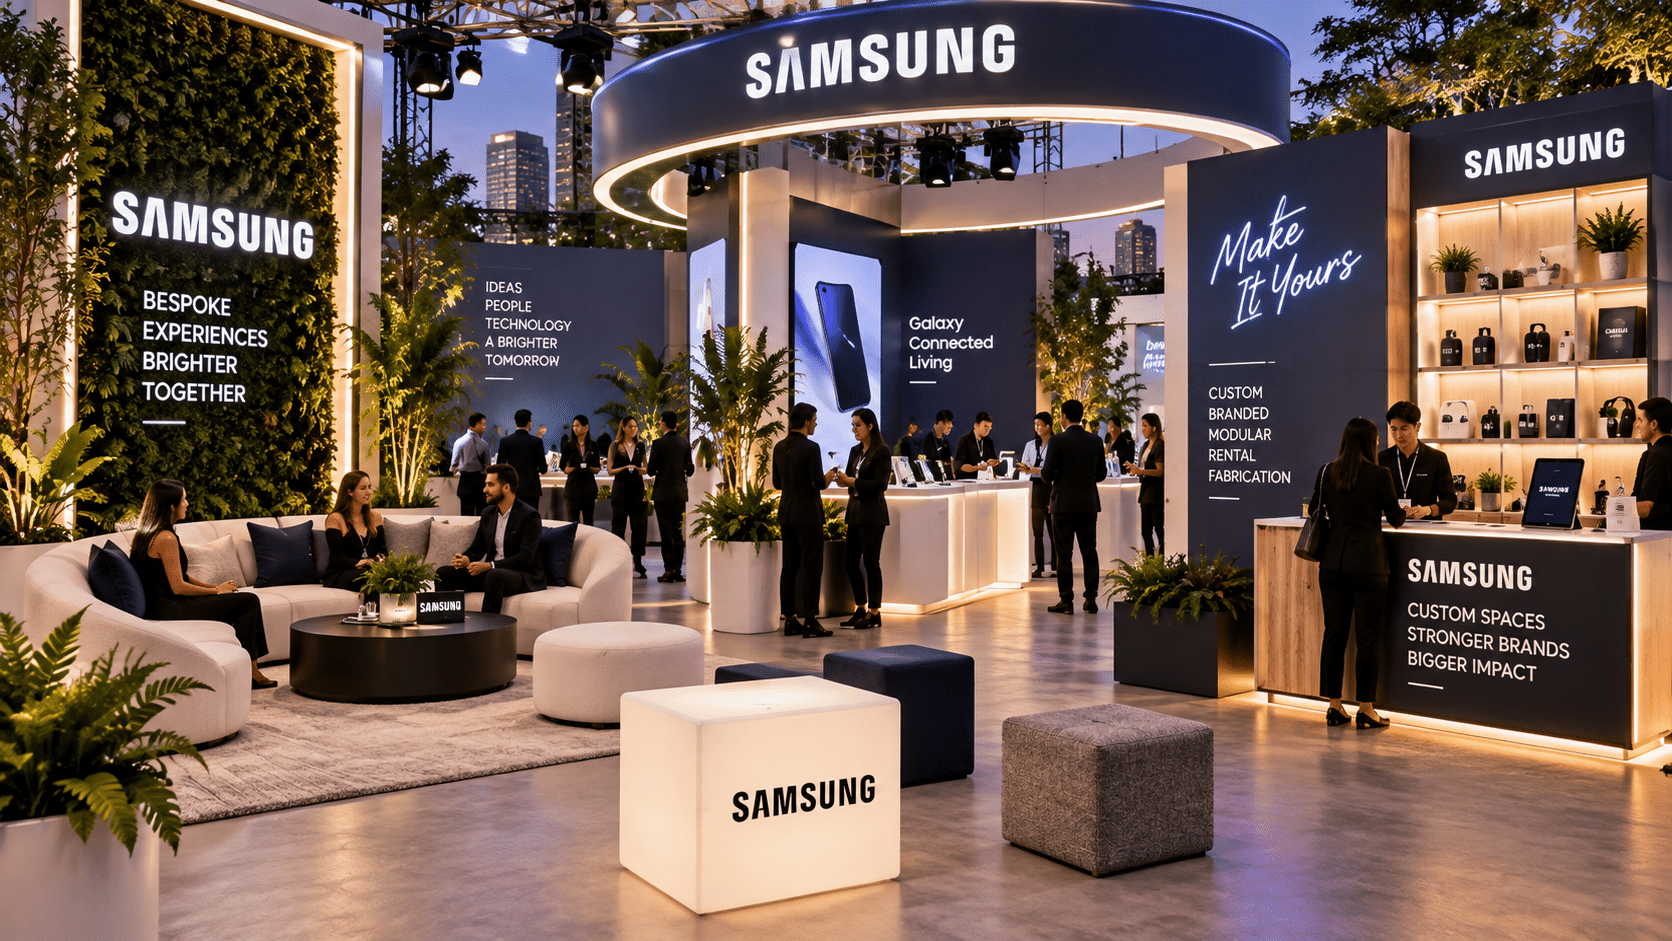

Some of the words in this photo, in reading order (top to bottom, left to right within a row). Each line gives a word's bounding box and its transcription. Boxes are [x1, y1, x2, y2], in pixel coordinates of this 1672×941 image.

[745, 24, 1016, 99] SAMSUNG
[1464, 128, 1626, 180] SAMSUNG
[112, 191, 314, 260] SAMSUNG
[1210, 195, 1306, 285] Make
[486, 281, 522, 293] IDEAS
[1231, 270, 1266, 329] It
[1272, 250, 1362, 315] Yours
[144, 290, 231, 316] BESPOKE
[486, 300, 531, 312] PEOPLE
[486, 318, 571, 331] TECHNOLOGY
[910, 316, 964, 332] Galaxy
[144, 321, 268, 349] EXPERIENCES
[485, 336, 494, 347] A
[498, 336, 557, 348] BRIGHTER
[909, 335, 993, 349] Connected
[143, 351, 237, 373] BRIGHTER
[485, 355, 559, 366] TOMORROW
[910, 355, 952, 372] Living
[142, 382, 245, 402] TOGETHER
[1209, 386, 1262, 399] CUSTOM
[1209, 407, 1268, 420] BRANDED
[1209, 428, 1271, 441] MODULAR
[1209, 449, 1256, 461] RENTAL
[1209, 470, 1290, 483] FABRICATION
[1407, 558, 1532, 591] SAMSUNG
[1408, 602, 1475, 623] CUSTOM
[1481, 609, 1545, 630] SPACES
[1408, 627, 1493, 650] STRONGER
[1499, 637, 1570, 660] BRANDS
[1408, 651, 1468, 673] BIGGER
[1472, 660, 1538, 682] IMPACT
[732, 774, 876, 823] SAMSUNG
